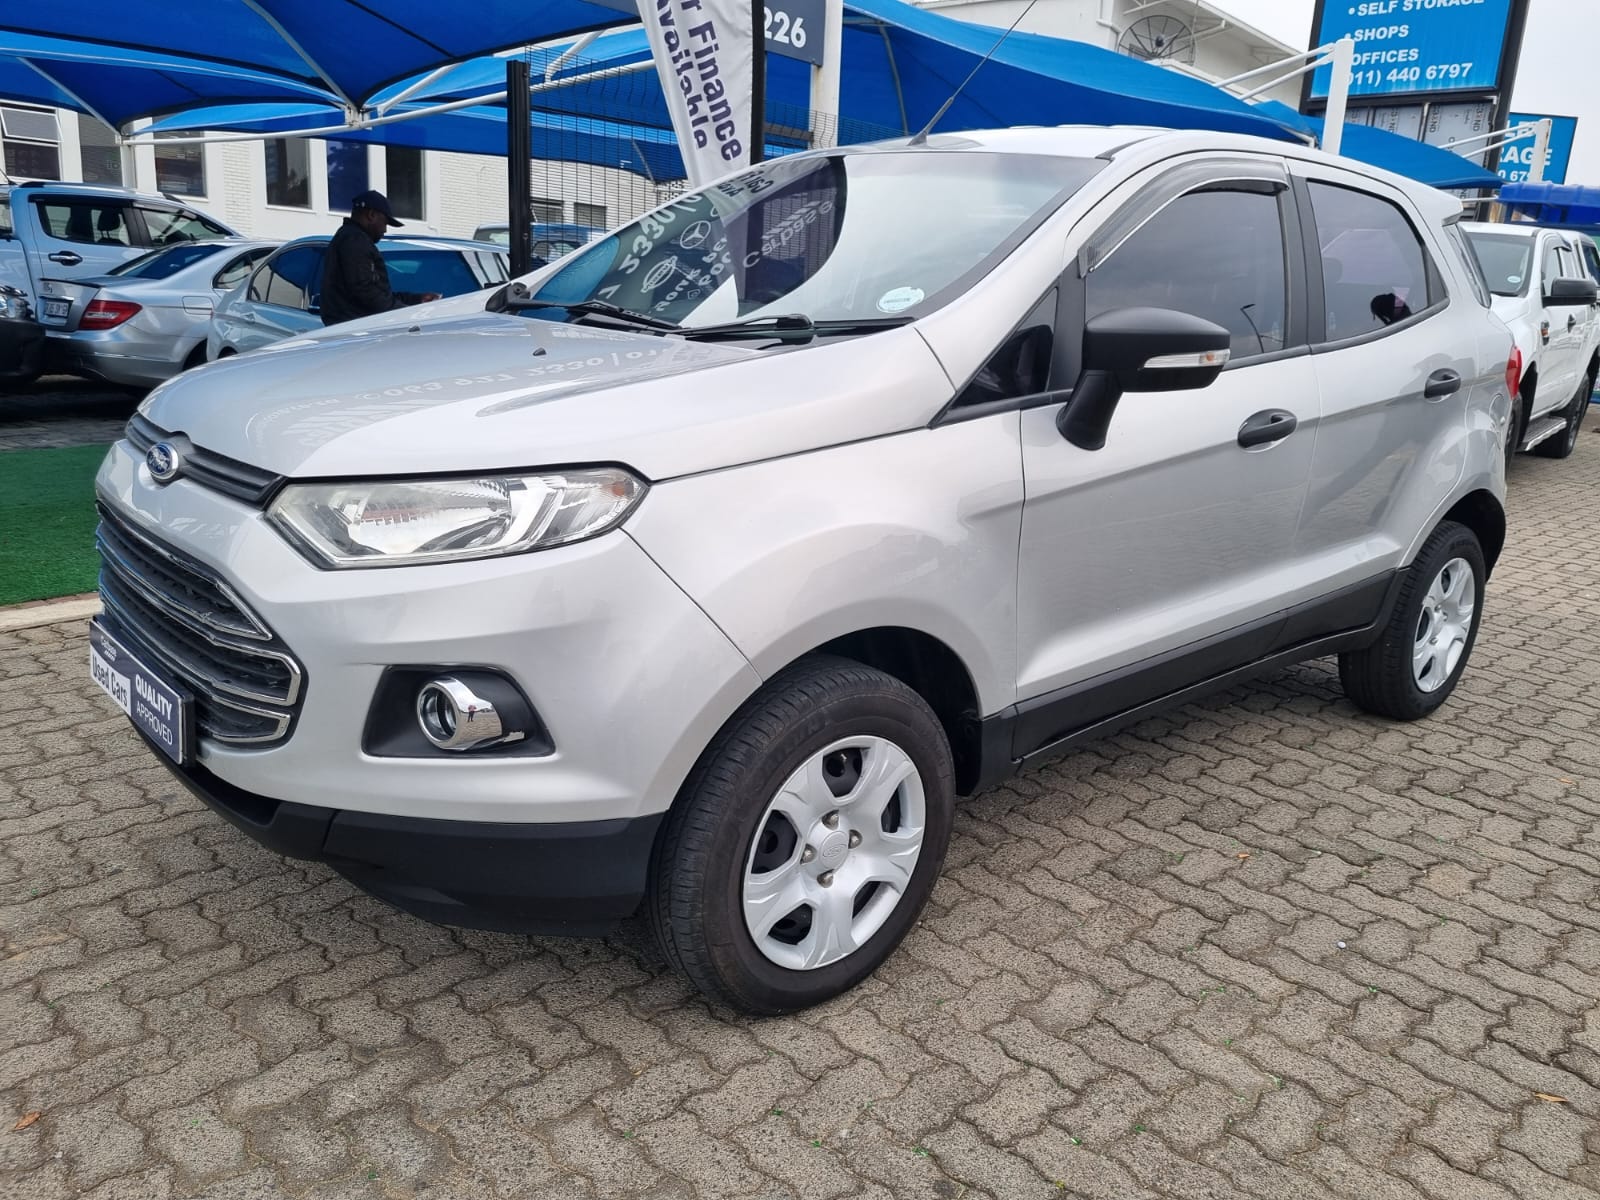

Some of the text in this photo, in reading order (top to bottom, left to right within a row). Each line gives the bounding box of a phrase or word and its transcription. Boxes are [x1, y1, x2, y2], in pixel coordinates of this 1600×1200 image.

[1357, 0, 1484, 16] SELF STORA
[1354, 25, 1409, 42] SHOPS
[1352, 48, 1419, 66] OFFICES
[1386, 66, 1421, 82] 440
[1425, 63, 1472, 80] 6797
[688, 21, 742, 160] Finance
[92, 655, 128, 708] Used Cars
[135, 673, 173, 721] QUALITY
[136, 700, 173, 746] APPROVED
